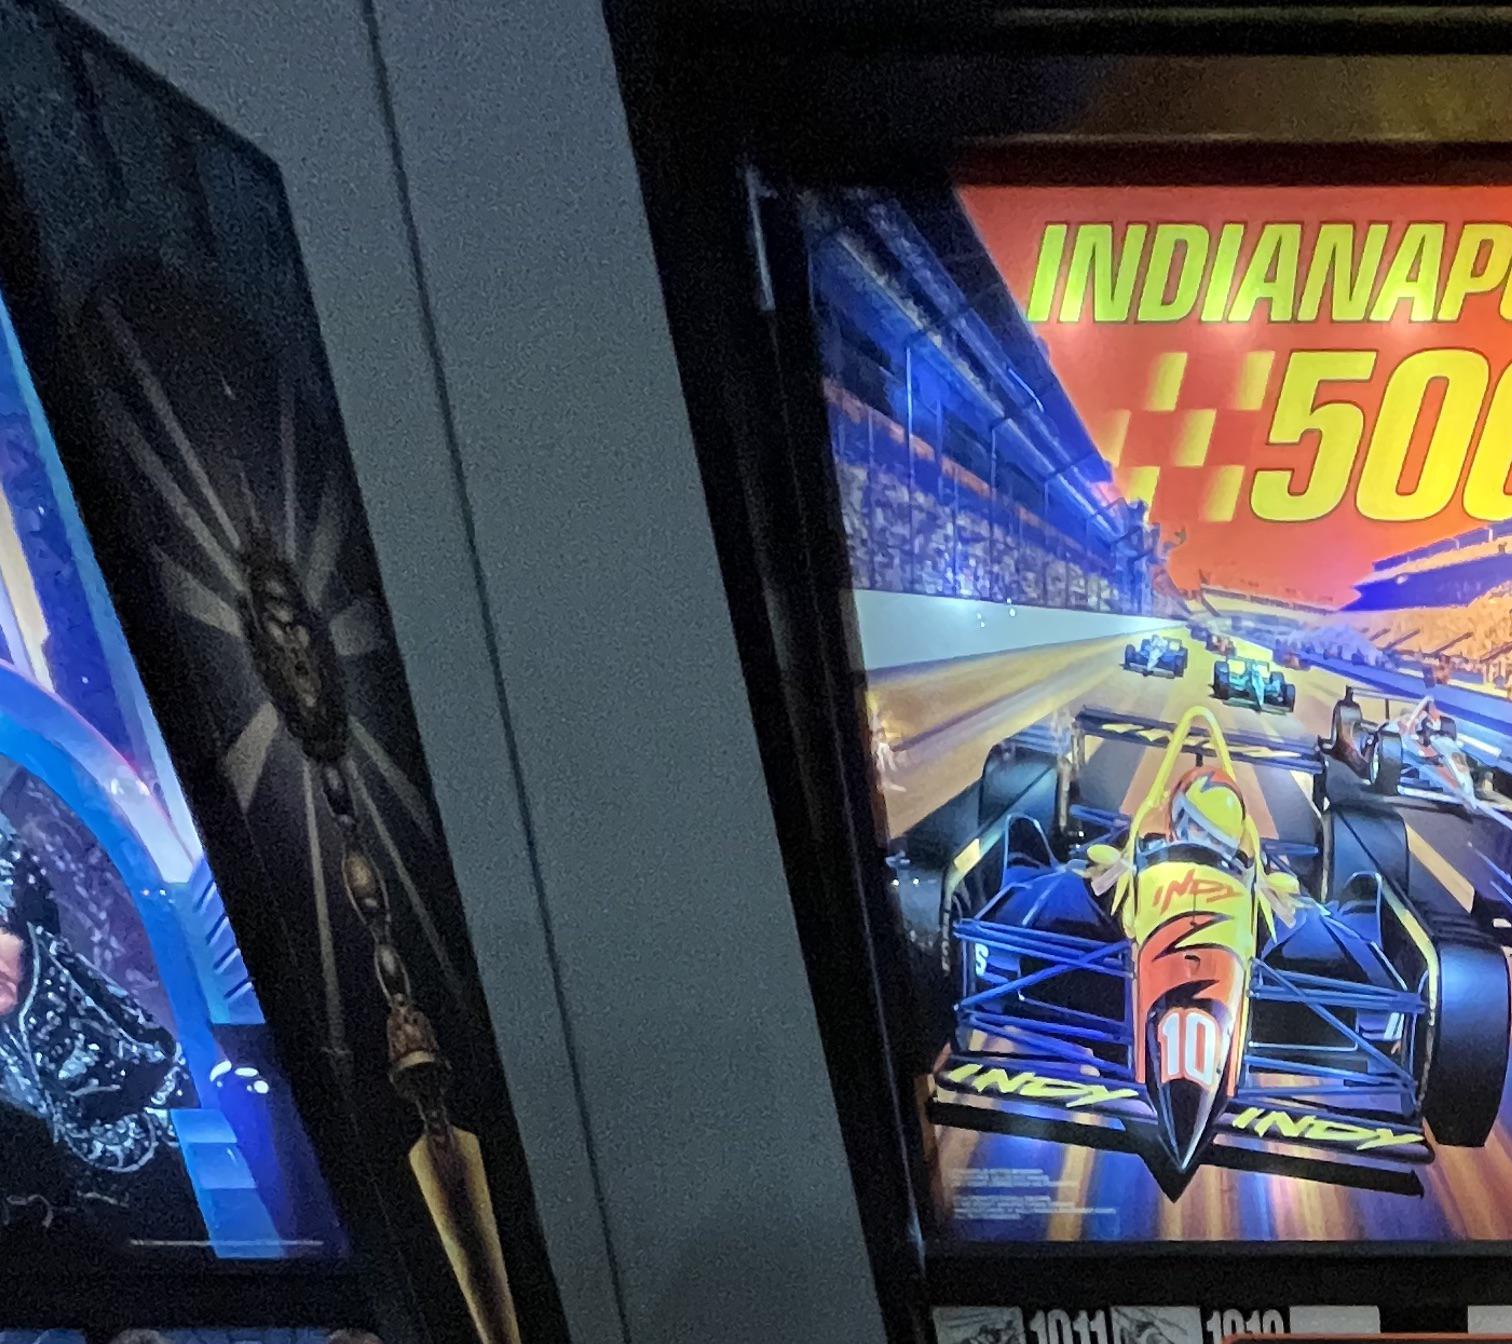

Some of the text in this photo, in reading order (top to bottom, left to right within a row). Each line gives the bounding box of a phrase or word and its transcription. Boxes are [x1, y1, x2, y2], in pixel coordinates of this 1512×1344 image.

[1157, 1008, 1218, 1089] 10
[946, 1062, 1140, 1108] INDY
[1232, 1106, 1426, 1151] INDY
